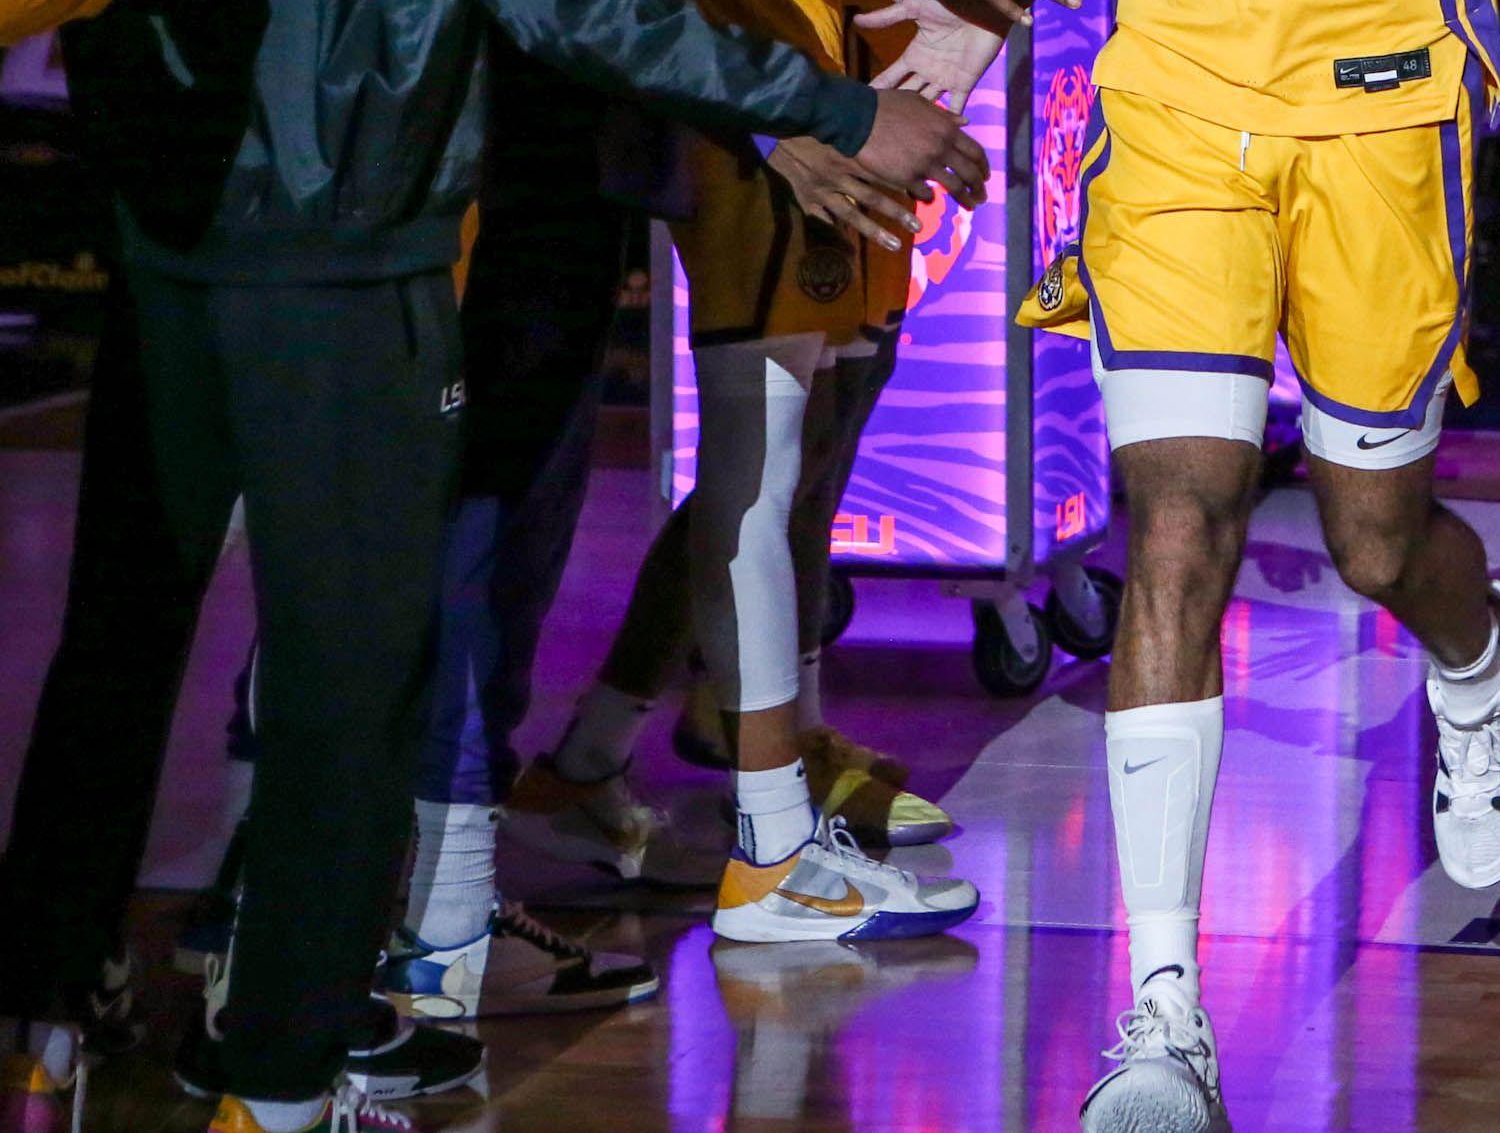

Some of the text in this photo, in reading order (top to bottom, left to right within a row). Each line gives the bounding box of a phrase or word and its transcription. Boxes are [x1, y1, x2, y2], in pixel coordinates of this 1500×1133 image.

[1403, 59, 1417, 72] 48
[830, 514, 895, 554] SU
[1057, 491, 1085, 541] LSU
